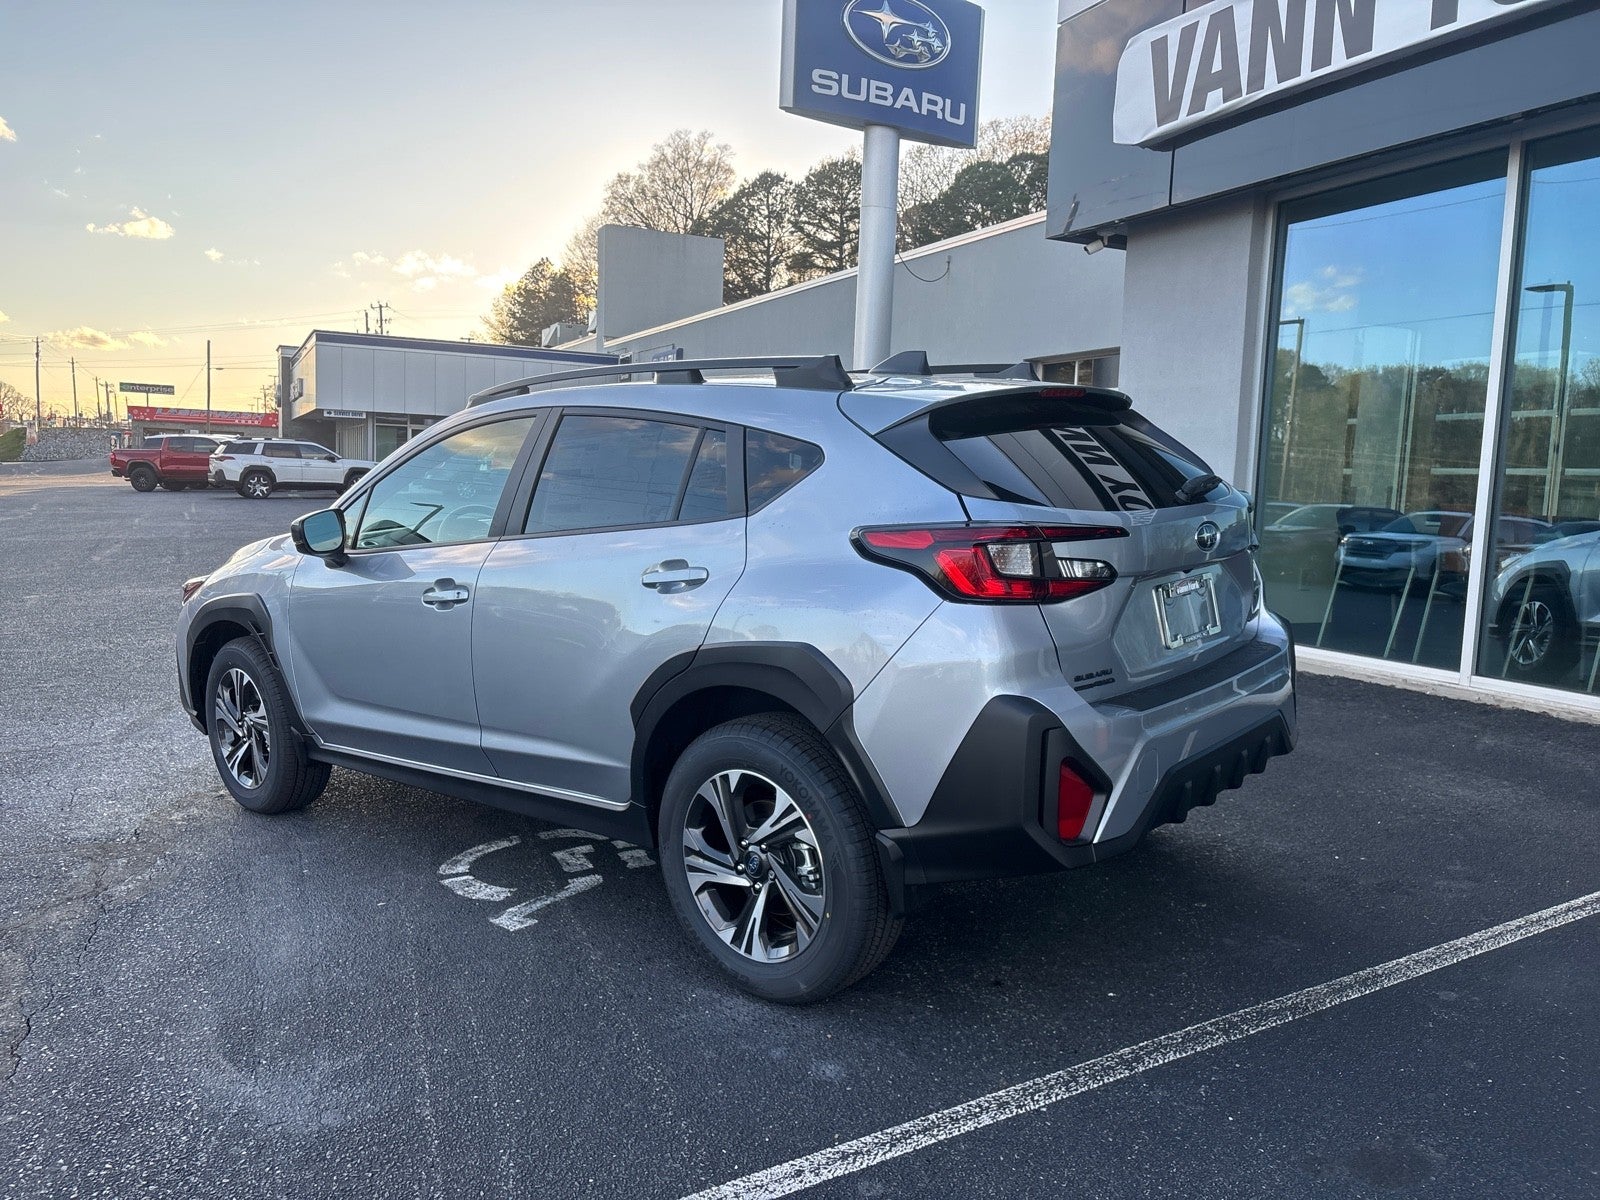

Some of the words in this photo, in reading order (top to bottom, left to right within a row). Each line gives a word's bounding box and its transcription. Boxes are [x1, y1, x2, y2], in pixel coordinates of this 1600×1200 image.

[1150, 0, 1376, 128] VANN
[811, 68, 966, 126] SUBARU
[121, 383, 174, 393] enterprise
[1073, 668, 1113, 682] SUBARU
[780, 763, 834, 842] YOKOHAMA
